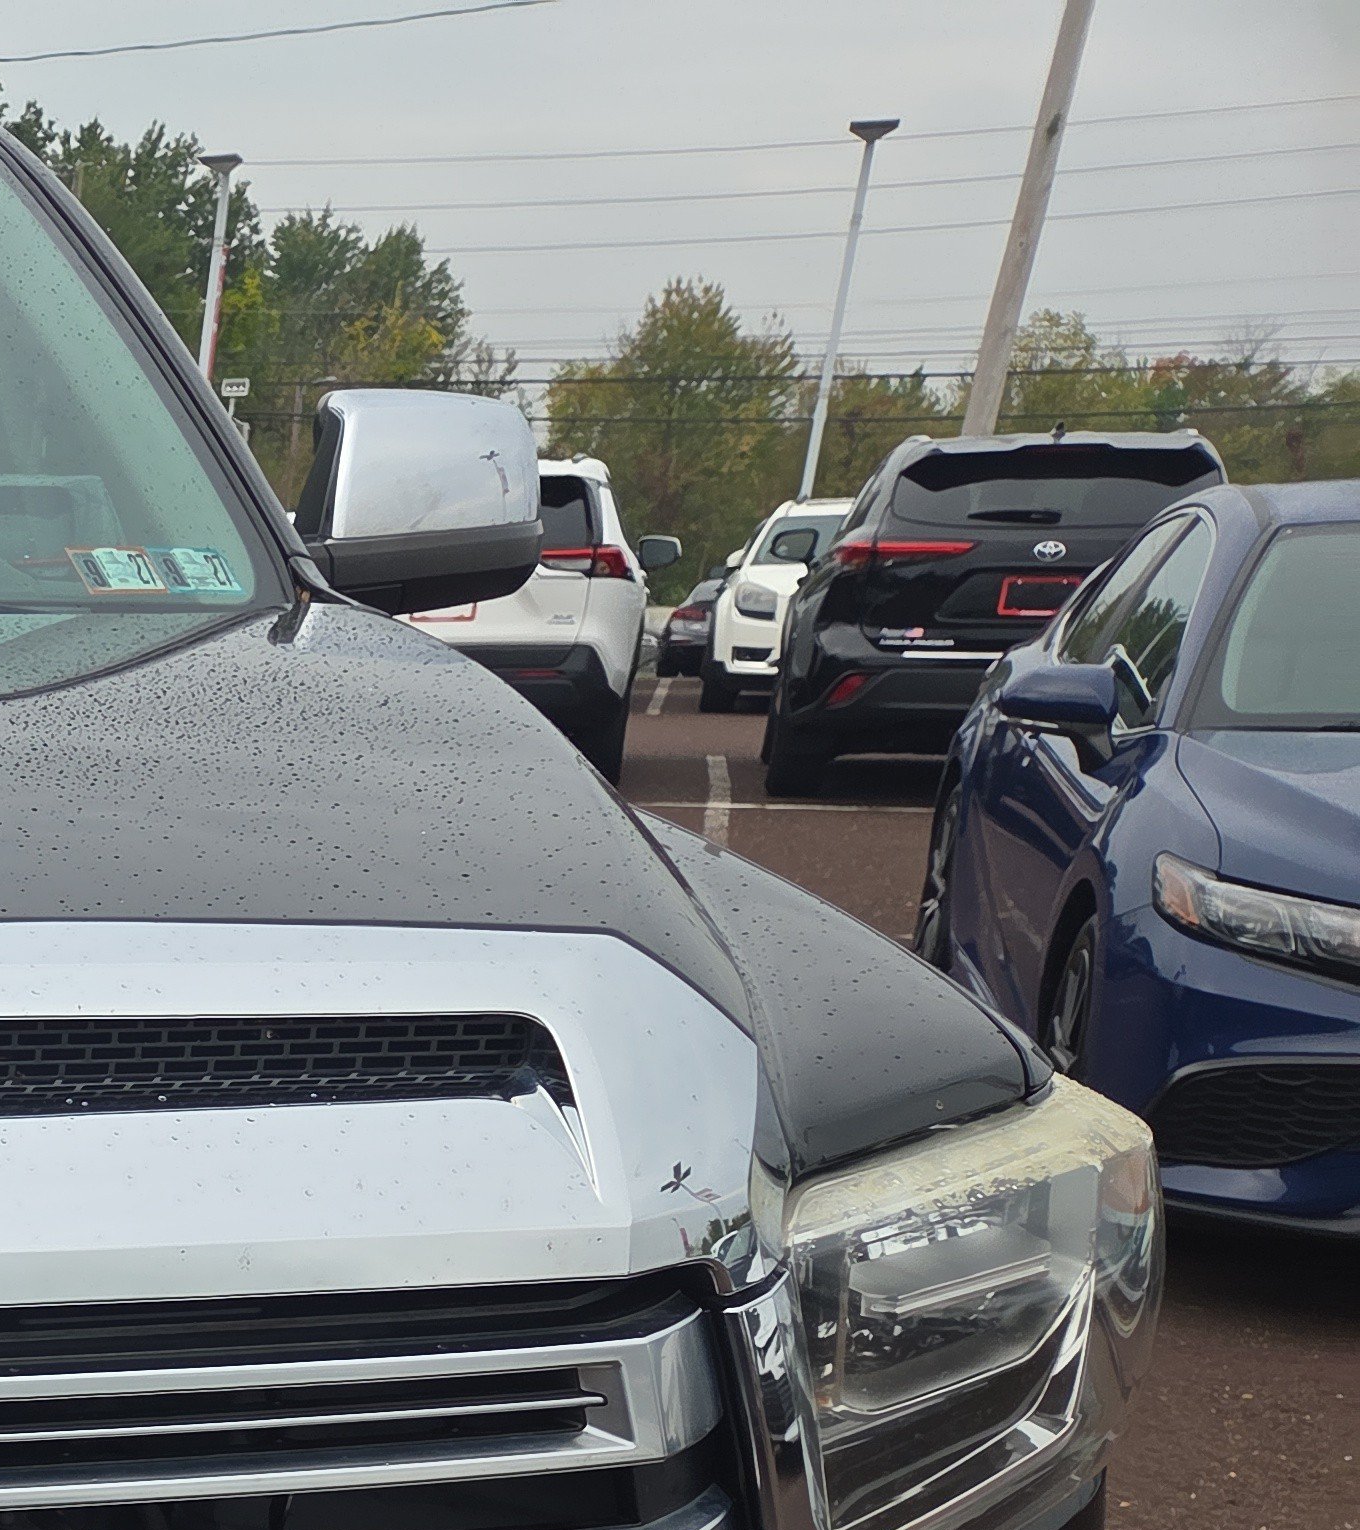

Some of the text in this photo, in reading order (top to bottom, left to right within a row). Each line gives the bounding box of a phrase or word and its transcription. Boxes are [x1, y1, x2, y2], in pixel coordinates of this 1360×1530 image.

[82, 553, 158, 588] 9 27
[203, 553, 233, 588] 27
